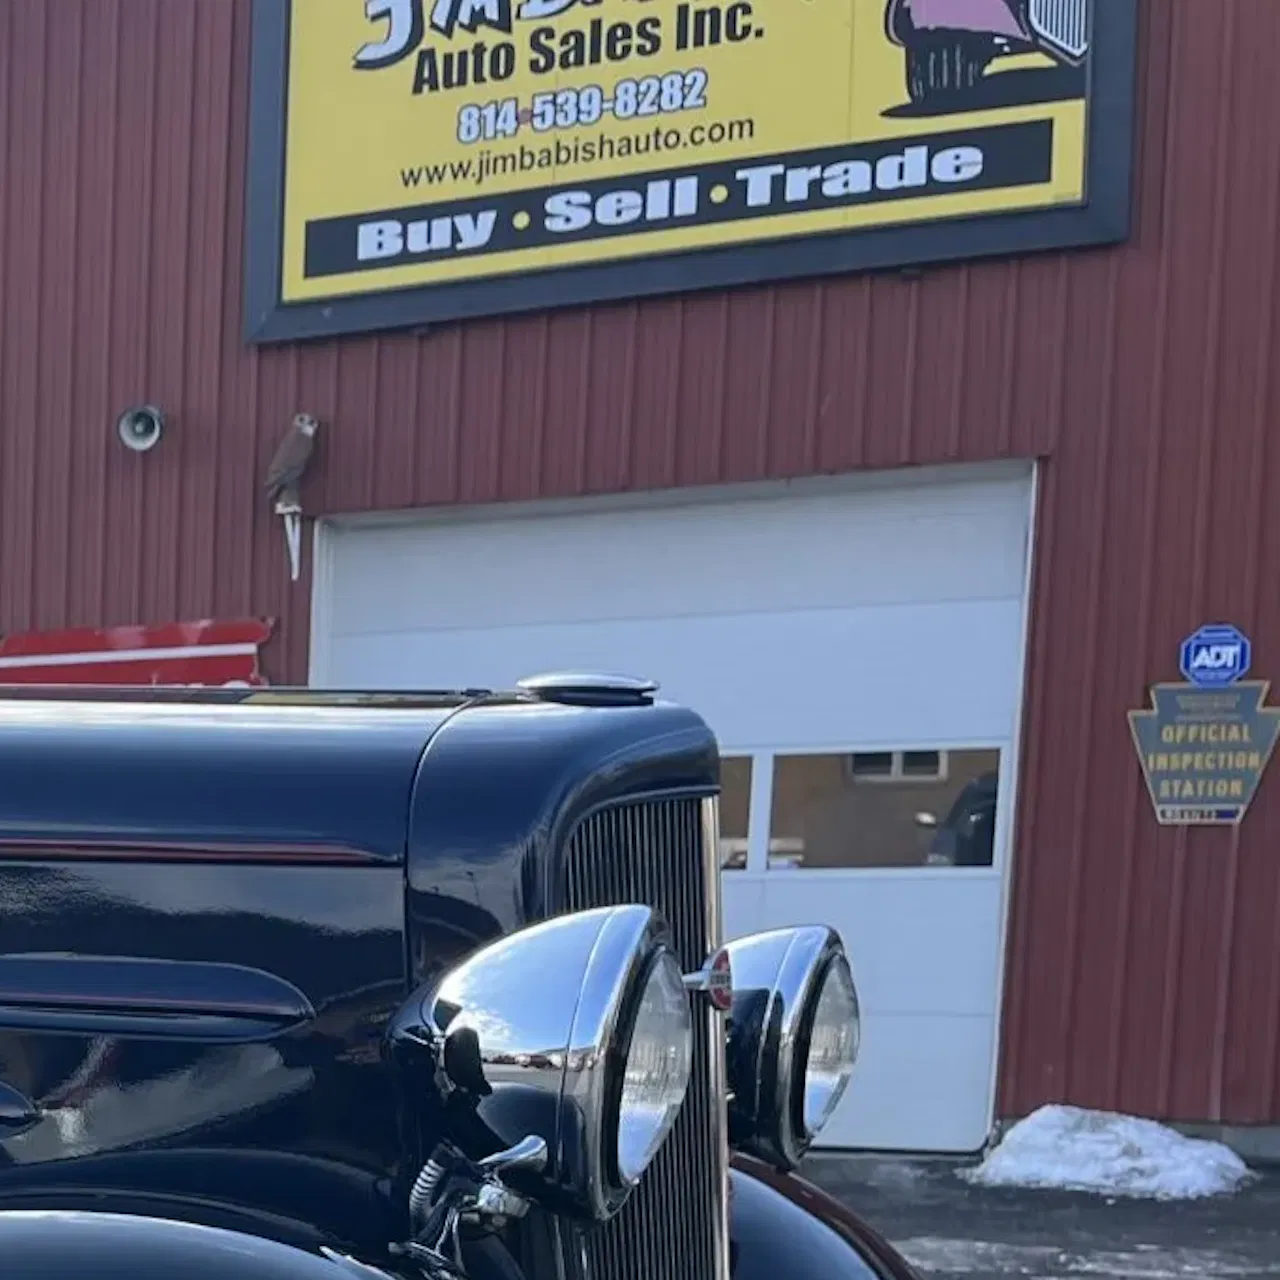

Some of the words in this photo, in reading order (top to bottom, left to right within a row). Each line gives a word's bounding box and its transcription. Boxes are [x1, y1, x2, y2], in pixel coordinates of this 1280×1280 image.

[412, 41, 515, 95] Auto
[529, 17, 662, 74] Sales
[676, 2, 765, 51] Inc.
[456, 67, 708, 144] 814-539-8282
[400, 117, 755, 188] www.jimbabishauto.com
[356, 209, 498, 261] Buy
[542, 175, 699, 233] Sell
[735, 145, 984, 208] Trade
[1190, 645, 1241, 669] ADT
[1161, 723, 1252, 744] OFFICIAL
[1147, 751, 1261, 772] INSPECTION
[1159, 778, 1243, 799] STATION
